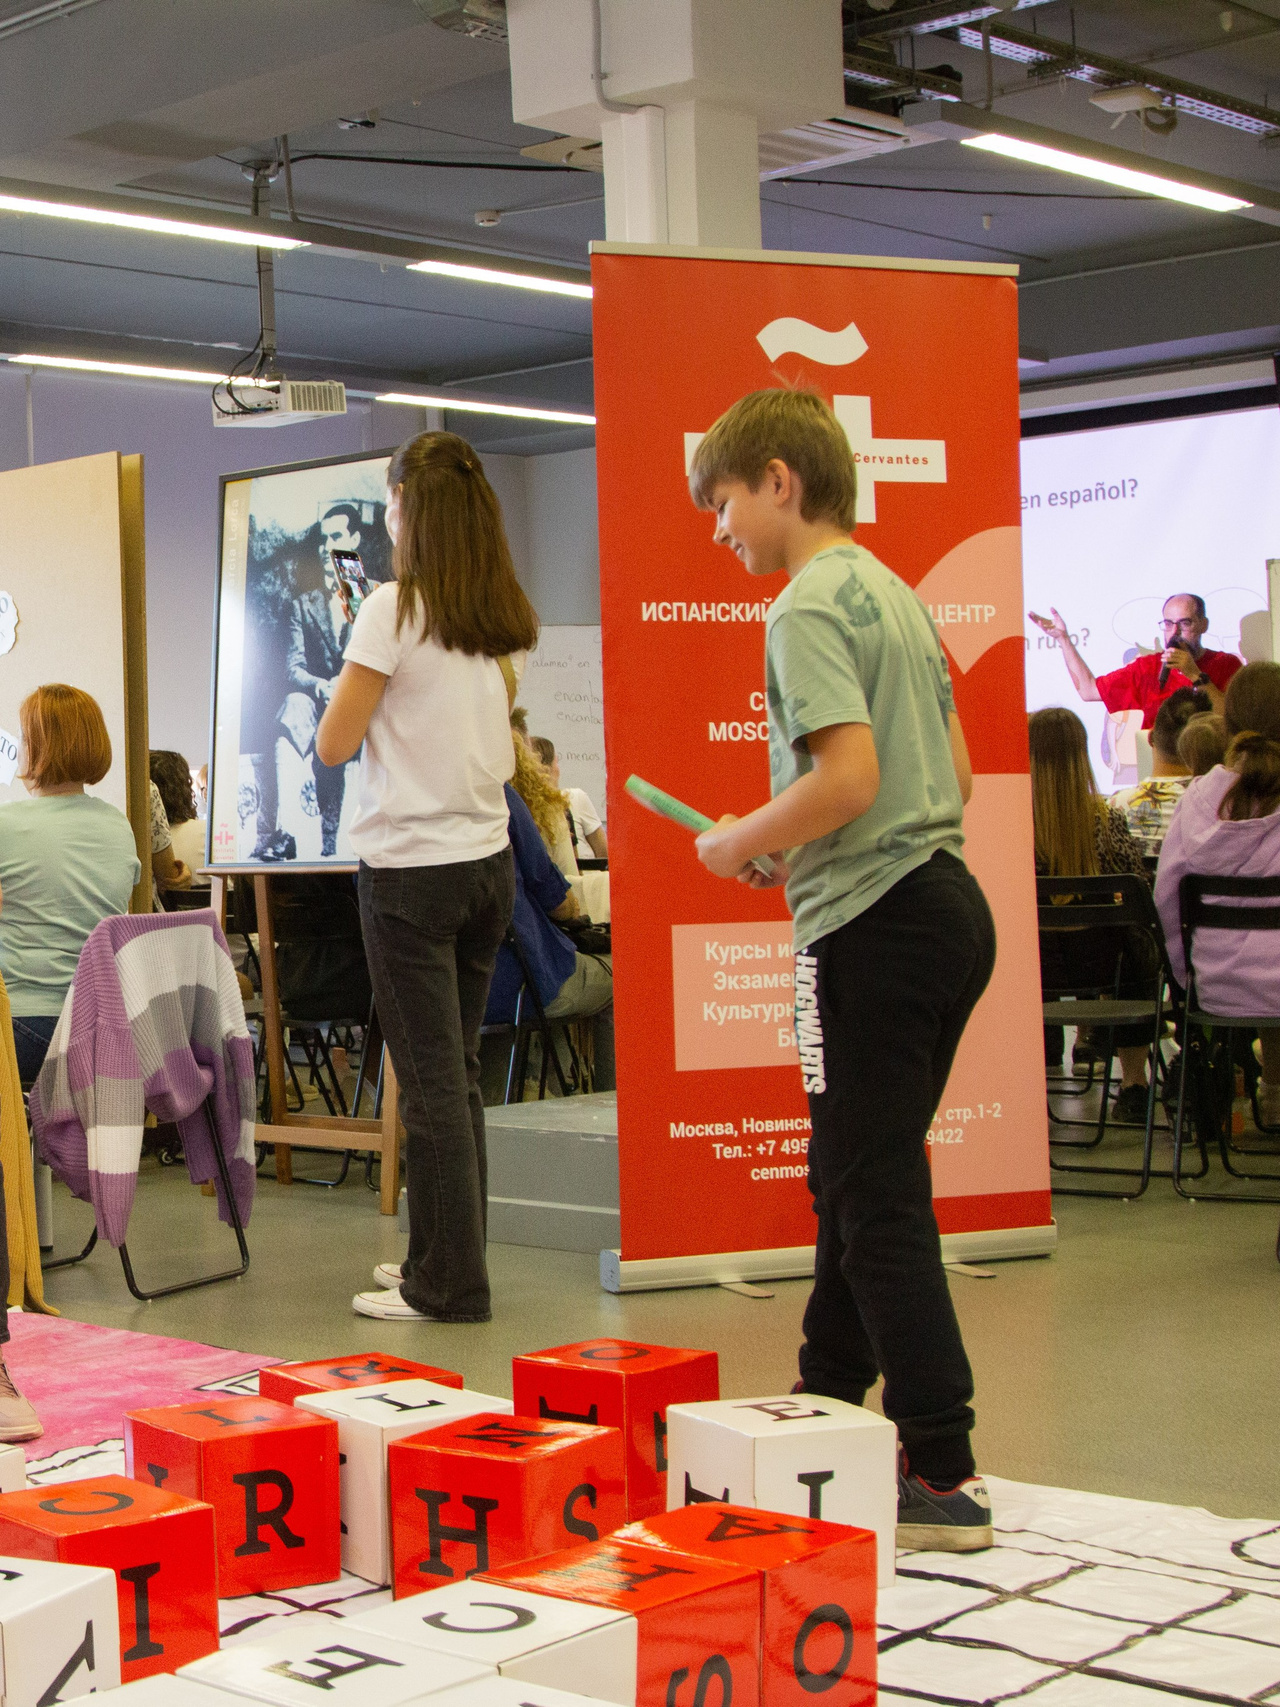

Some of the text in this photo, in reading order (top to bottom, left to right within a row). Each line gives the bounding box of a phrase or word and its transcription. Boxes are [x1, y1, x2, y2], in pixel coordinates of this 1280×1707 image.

[853, 453, 929, 466] Cervantes
[1048, 479, 1138, 509] español?
[928, 604, 996, 627] ЦЕНТР
[705, 942, 771, 966] Курсы
[713, 970, 796, 991] Экзаме
[795, 954, 827, 1094] HOGWARTS
[670, 1121, 739, 1139] Москва,
[945, 1102, 1002, 1124] стр.1-2
[712, 1143, 752, 1159] Тел.:
[756, 1140, 776, 1156] +7
[354, 1393, 447, 1412] L
[732, 1401, 832, 1421] E
[183, 1409, 272, 1427] L
[232, 1469, 306, 1557] R
[705, 1511, 815, 1542] A
[415, 1487, 499, 1578] H
[120, 1562, 164, 1662] I
[422, 1602, 538, 1633] C
[793, 1603, 854, 1693] O
[262, 1645, 407, 1691] E
